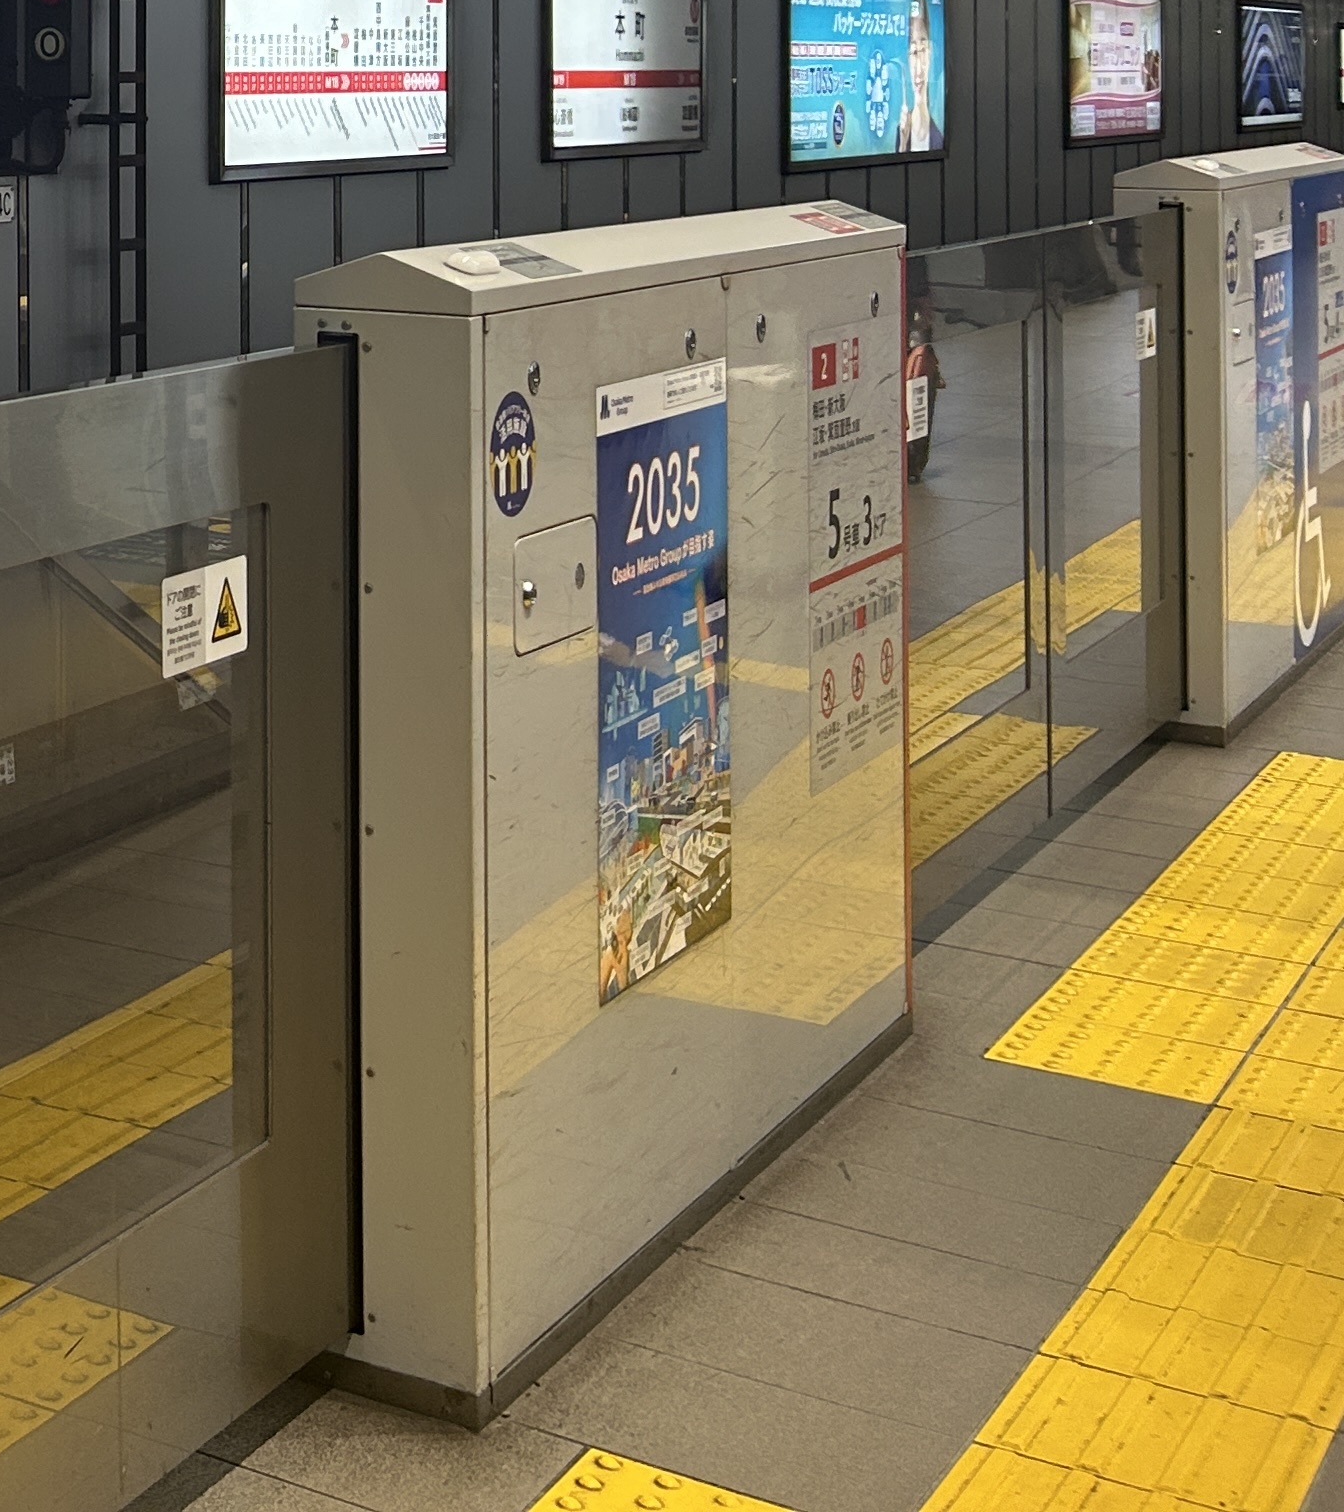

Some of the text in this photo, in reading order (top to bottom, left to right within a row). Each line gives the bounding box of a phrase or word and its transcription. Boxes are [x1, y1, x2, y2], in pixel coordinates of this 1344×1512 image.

[615, 10, 646, 41] 本町
[821, 352, 828, 380] 2
[626, 444, 700, 545] 2035
[612, 562, 636, 585] Osaka
